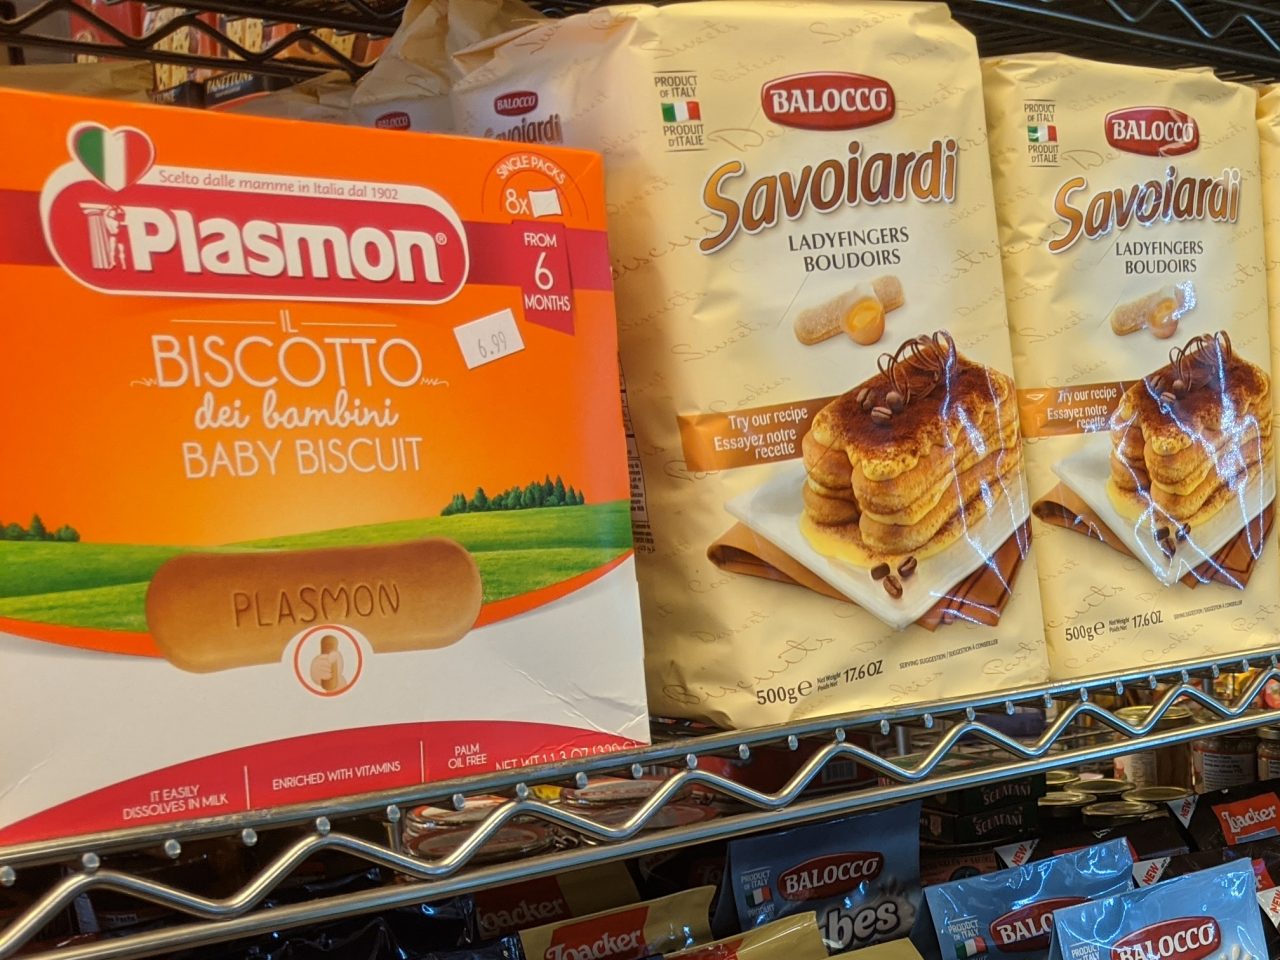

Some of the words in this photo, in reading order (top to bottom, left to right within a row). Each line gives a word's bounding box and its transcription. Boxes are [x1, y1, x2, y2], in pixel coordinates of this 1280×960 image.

[654, 75, 698, 88] PRODUCT
[496, 98, 536, 110] BALOCCO
[770, 87, 888, 114] BALOCCO
[663, 124, 705, 137] PRODUIT
[1112, 120, 1194, 143] BALOCCO
[496, 155, 531, 179] SINGLE
[532, 157, 567, 182] PACKS
[159, 169, 200, 187] Scelto
[203, 172, 236, 189] dalle
[239, 178, 295, 194] mamme
[299, 179, 310, 193] in
[314, 181, 345, 197] Italia
[348, 183, 367, 199] dal
[370, 186, 399, 201] 1902
[700, 139, 959, 255] Savoiardi
[505, 189, 530, 214] 8x
[1049, 166, 1240, 254] Savoiardi
[124, 207, 444, 284] Plasmon
[524, 232, 557, 248] FROM
[788, 227, 910, 252] LADYFINGERS
[1115, 241, 1204, 256] LADYFINGERS
[534, 252, 554, 291] 6
[804, 250, 901, 273] BOUDOIRS
[1125, 258, 1197, 274] BOUDOIRS
[524, 294, 571, 312] MONTHS
[478, 331, 509, 360] 6.99
[152, 333, 423, 388] BISCOTTO
[195, 392, 250, 430] dei
[262, 390, 400, 429] bambini
[728, 415, 749, 431] Try
[752, 412, 772, 427] our
[773, 406, 808, 425] recipe
[713, 431, 765, 453] Essayez
[766, 427, 797, 447] notre
[754, 441, 795, 461] recette
[183, 440, 281, 480] BABY
[295, 438, 423, 476] BISCUIT
[233, 582, 402, 630] PLASMON
[447, 756, 463, 770] OIL
[465, 753, 487, 767] FREE
[454, 743, 480, 757] PALM
[272, 774, 326, 791] ENRICHED
[328, 768, 358, 783] WITH
[359, 761, 401, 779] VITAMINS
[122, 797, 185, 820] DISSOLVES
[187, 796, 199, 810] IN
[201, 793, 228, 808] MILK
[150, 789, 161, 803] IT
[164, 785, 200, 802] EASILY
[1180, 800, 1191, 819] NEW
[1222, 805, 1276, 833] Loacker
[1012, 845, 1028, 865] NEW
[784, 857, 879, 894] BALOCCO
[1143, 863, 1159, 885] NEW
[997, 914, 1054, 945] BALO
